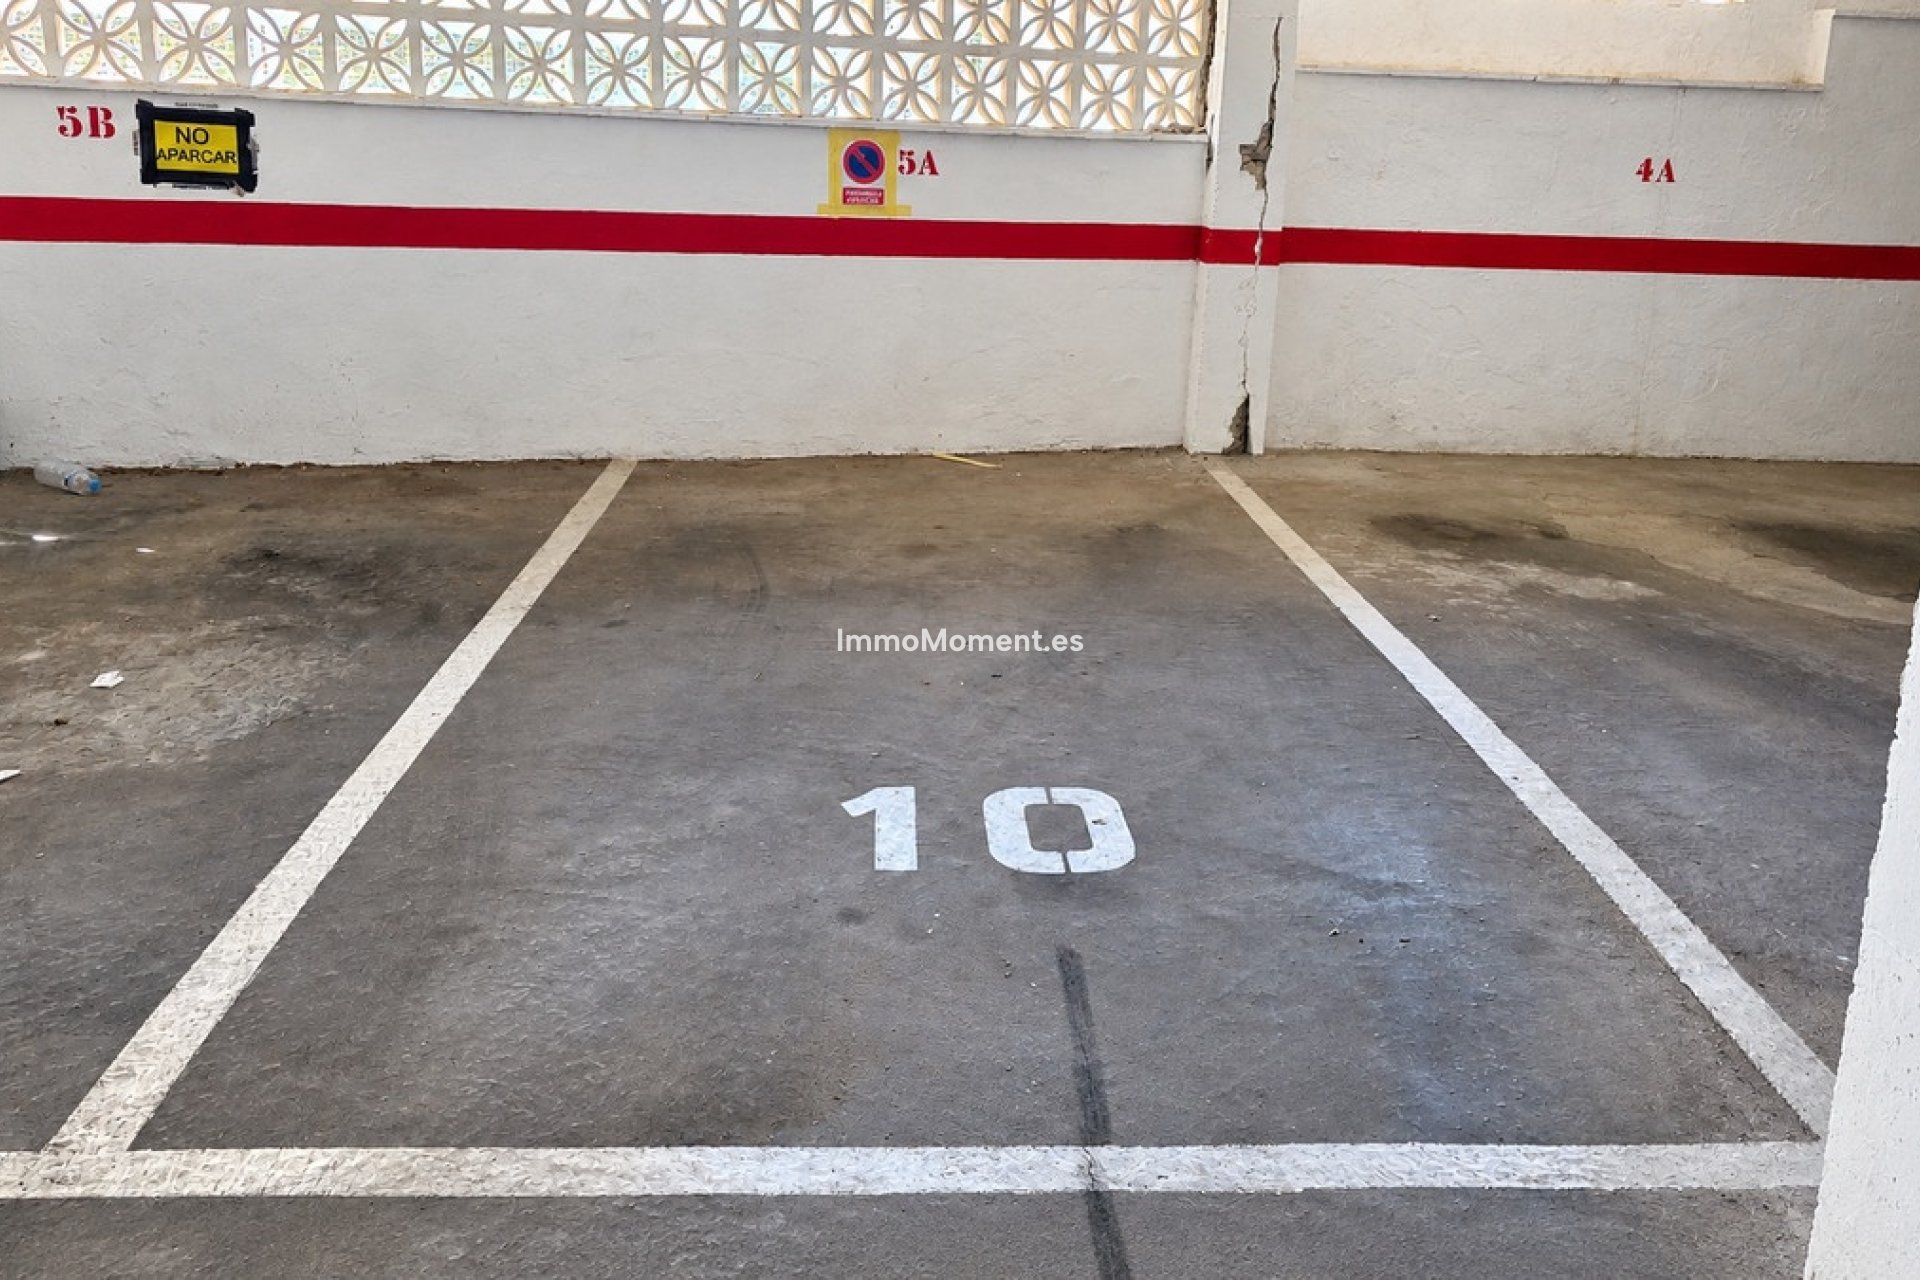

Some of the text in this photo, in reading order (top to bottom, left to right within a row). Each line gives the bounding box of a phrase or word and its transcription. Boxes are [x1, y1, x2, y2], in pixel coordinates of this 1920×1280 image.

[56, 105, 116, 139] 5B
[175, 126, 210, 145] NO
[156, 147, 237, 164] APARCAR
[898, 149, 939, 176] 5A
[1635, 157, 1675, 183] 4A
[841, 786, 1136, 873] 10
